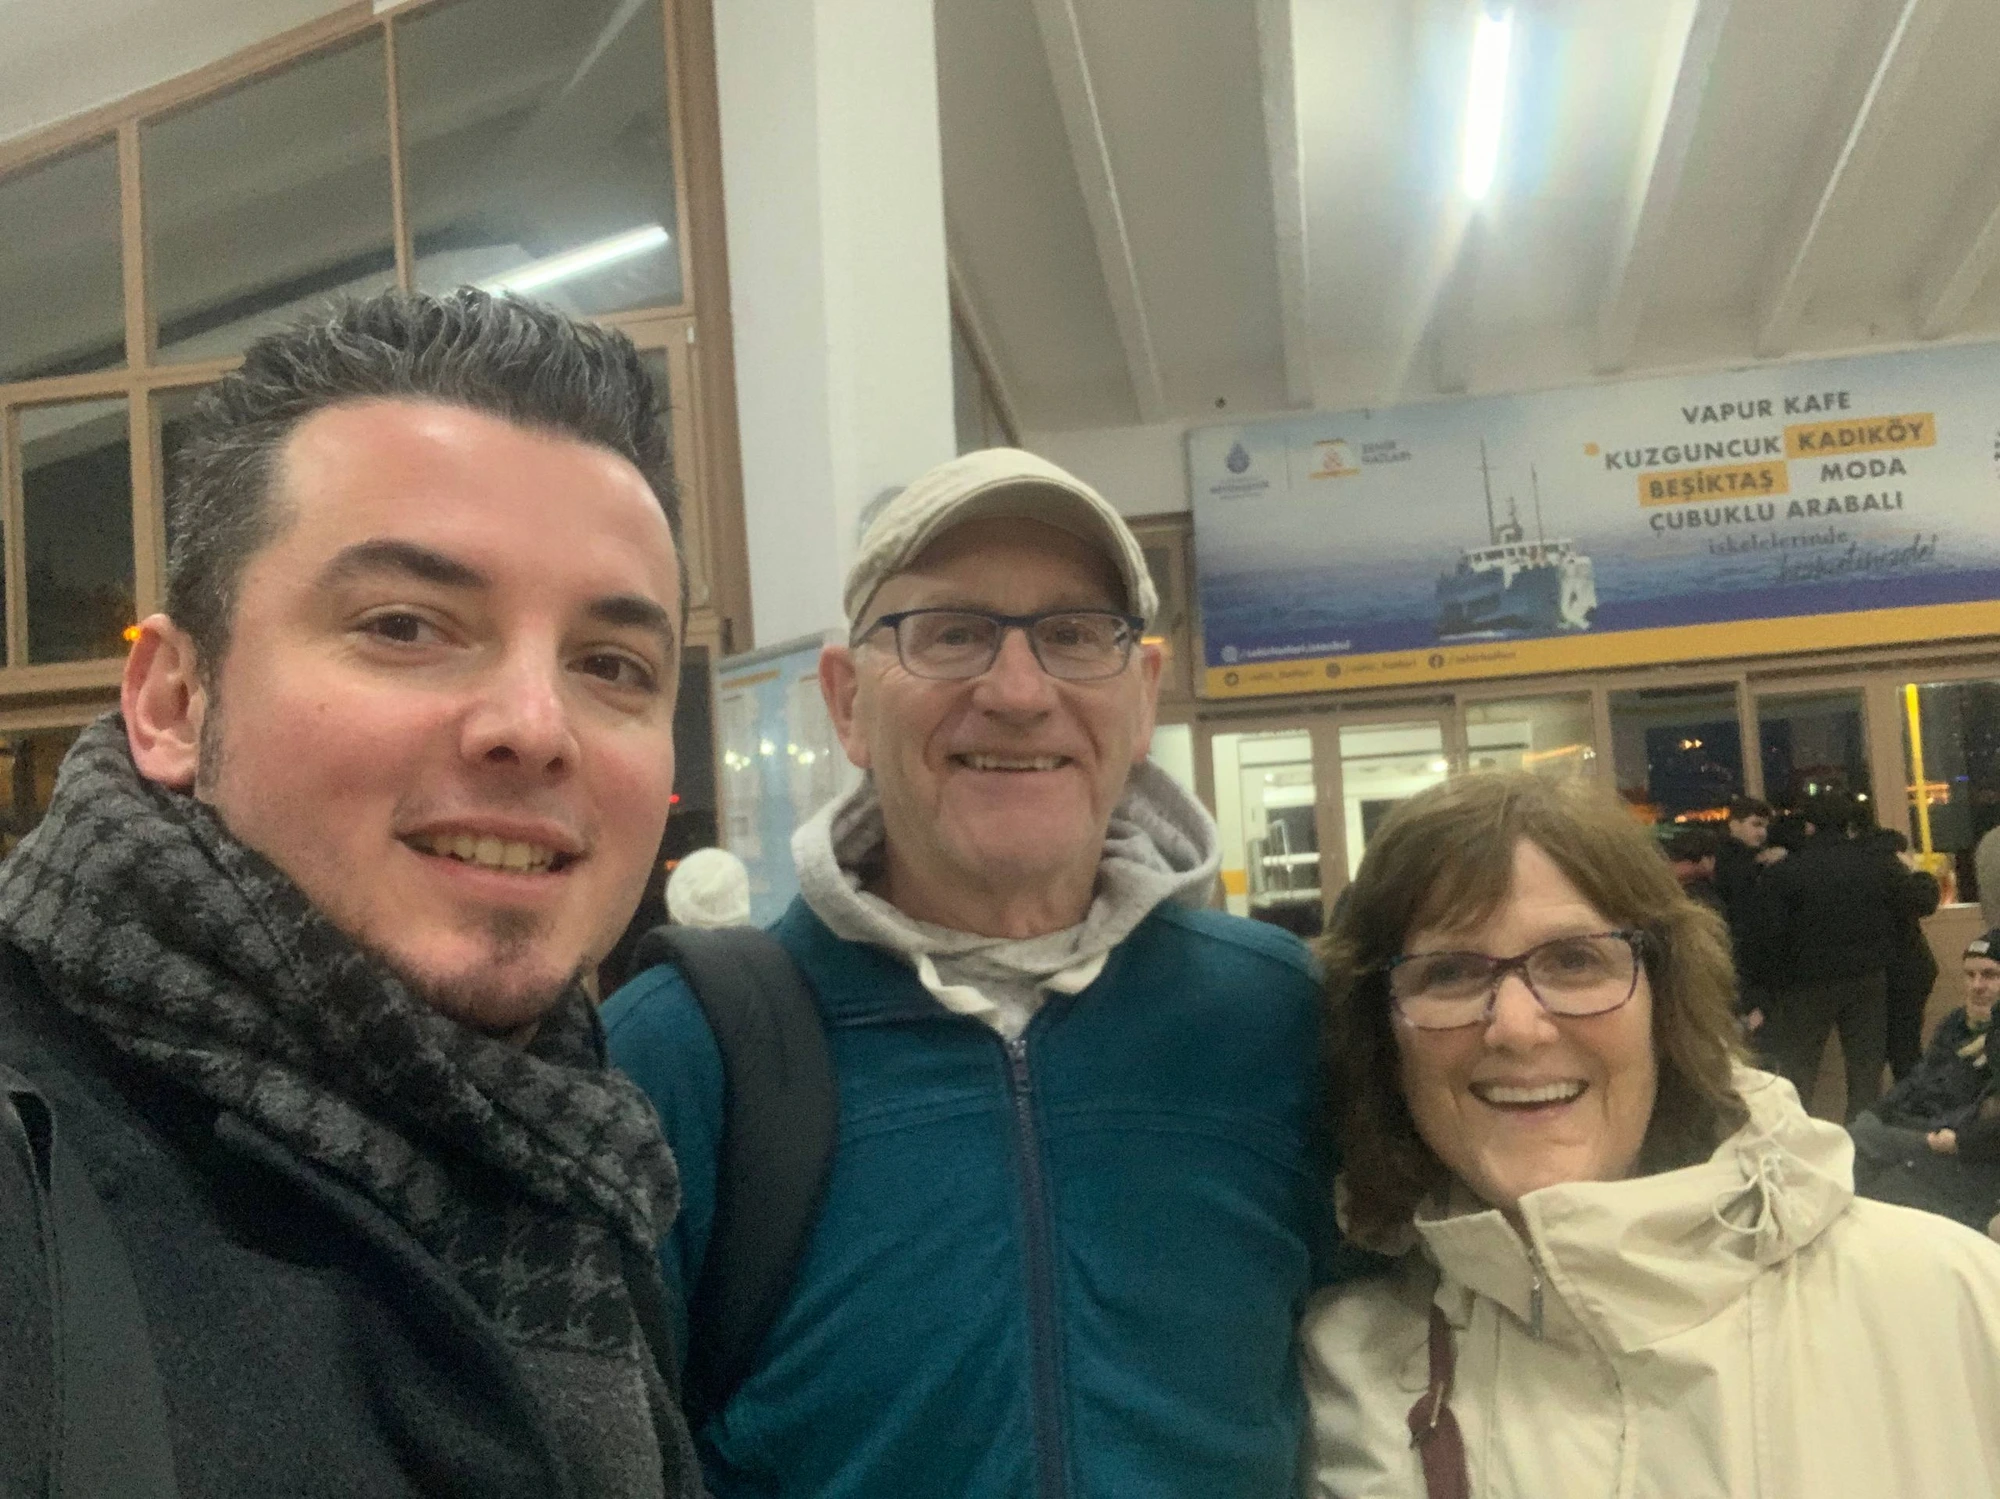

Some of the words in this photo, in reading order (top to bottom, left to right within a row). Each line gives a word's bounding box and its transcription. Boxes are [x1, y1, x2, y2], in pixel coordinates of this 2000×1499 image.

[1682, 398, 1773, 424] VAPUR
[1785, 391, 1852, 415] KAFE
[1605, 436, 1782, 470] KUZGUNCUK
[1798, 418, 1925, 451] KADIKÖY
[1649, 468, 1775, 501] BEŞİKTAŞ
[1820, 458, 1907, 482] MODA
[1649, 504, 1775, 538] ÇUBUKLU
[1787, 491, 1904, 519] ARABALI
